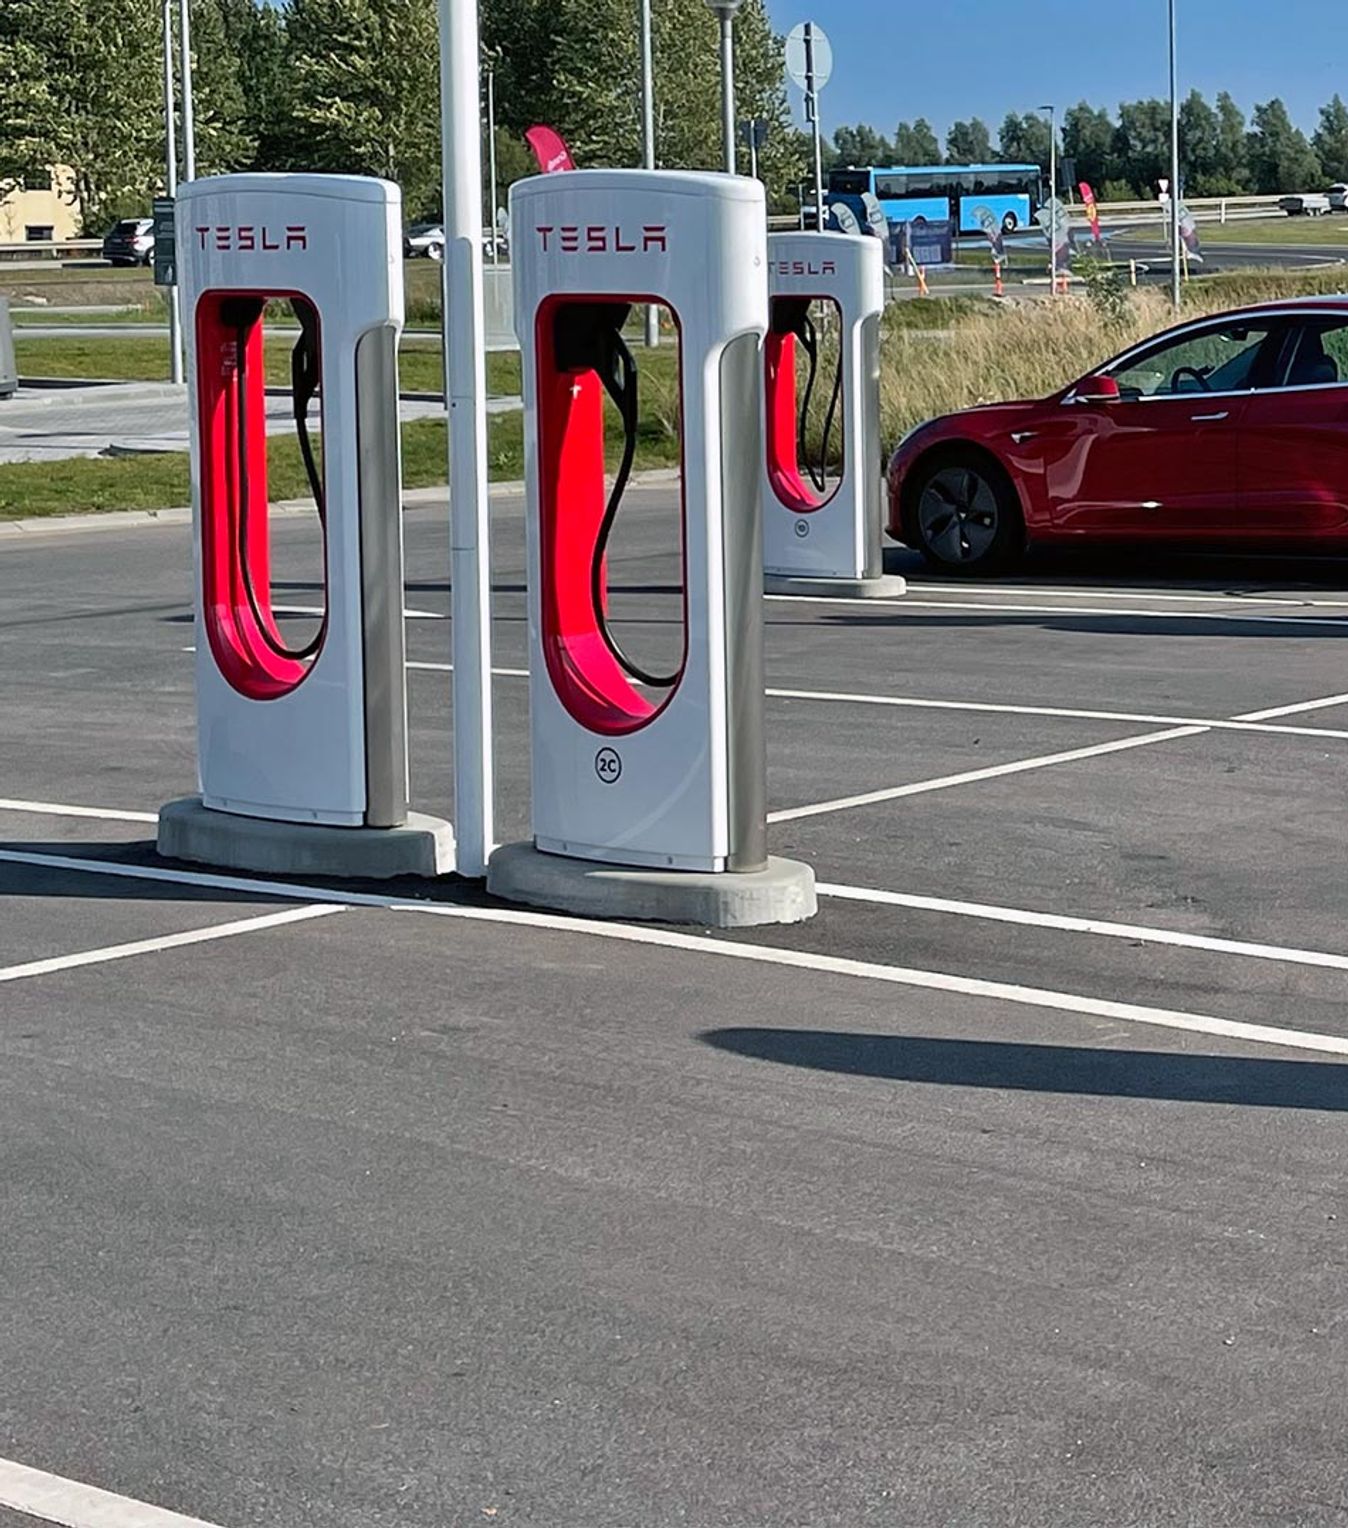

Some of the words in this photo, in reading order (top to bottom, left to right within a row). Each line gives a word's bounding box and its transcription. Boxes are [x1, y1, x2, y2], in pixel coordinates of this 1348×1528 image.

[195, 226, 308, 251] TESLA
[535, 226, 667, 252] TESLA
[768, 261, 836, 275] TESLA
[599, 757, 617, 773] 2C
